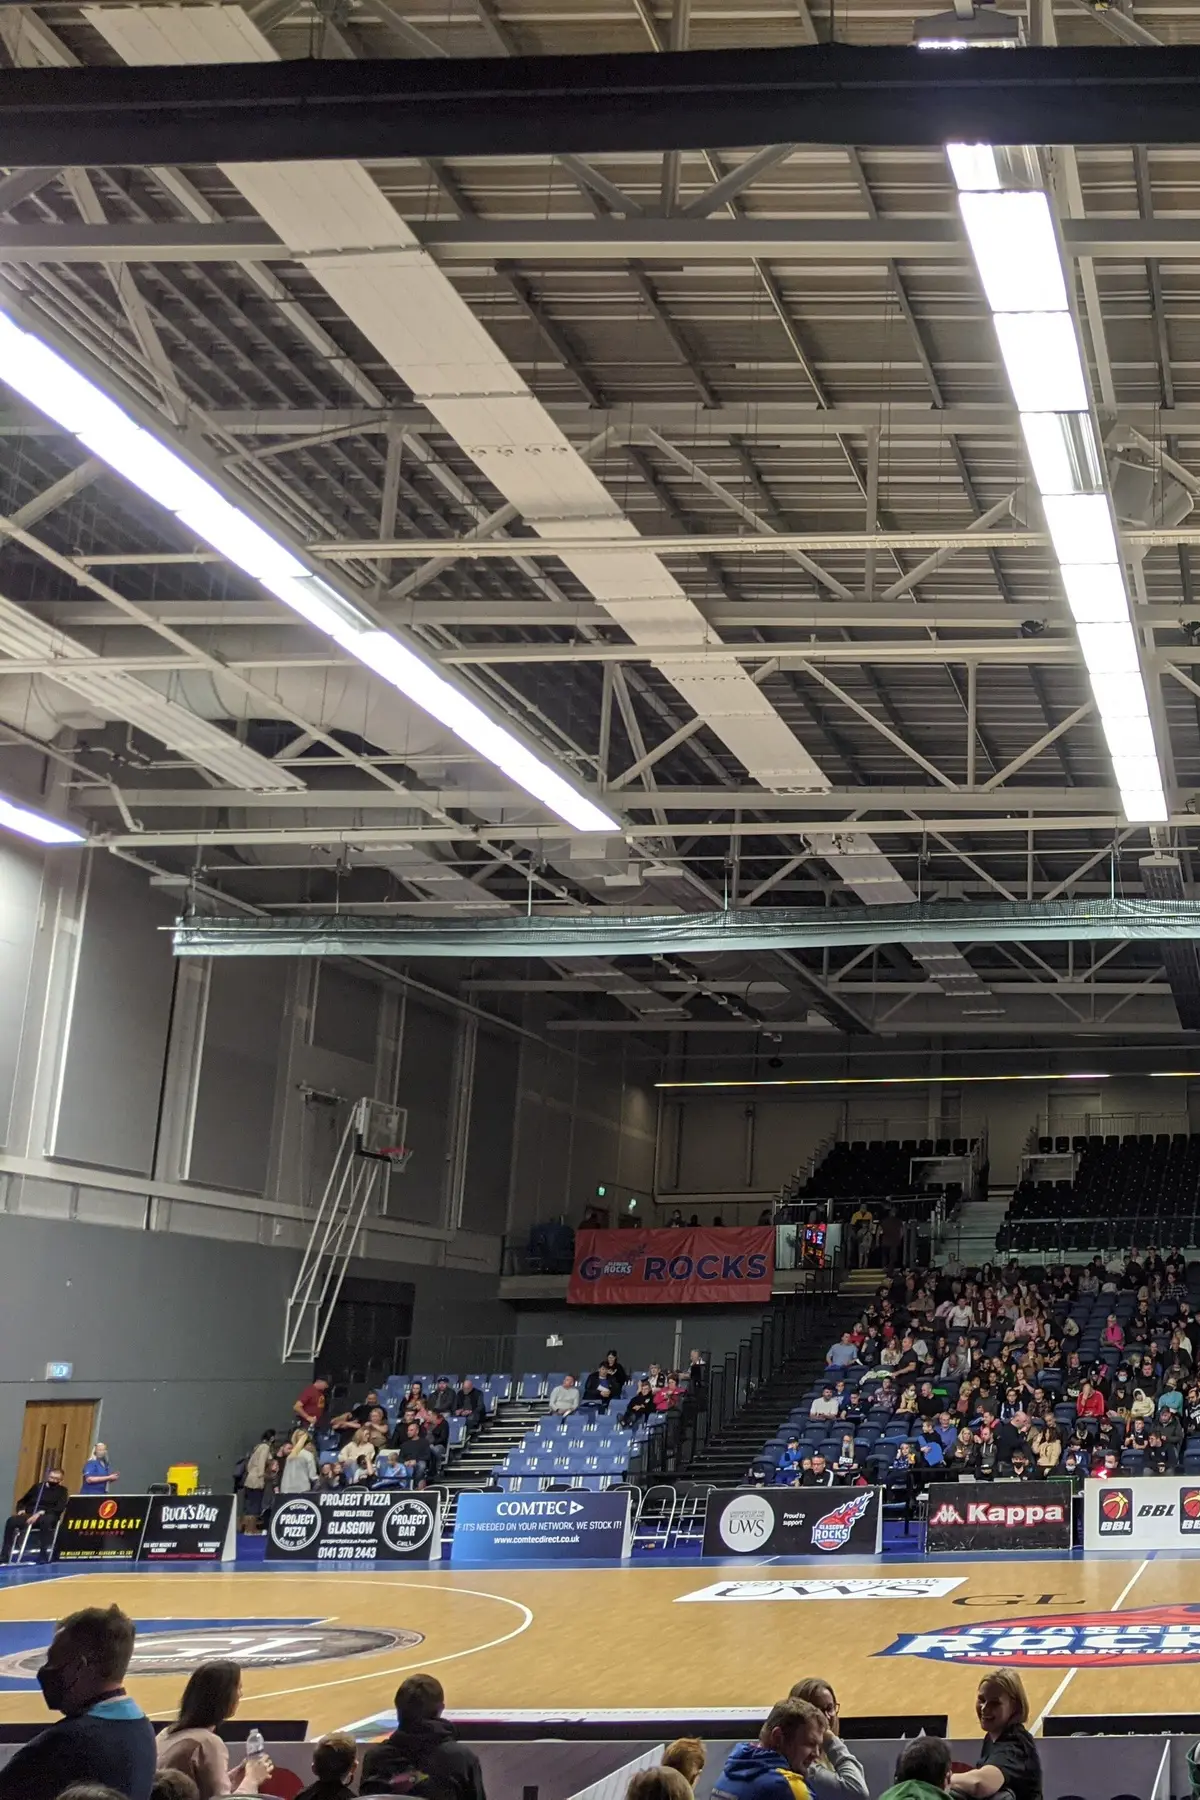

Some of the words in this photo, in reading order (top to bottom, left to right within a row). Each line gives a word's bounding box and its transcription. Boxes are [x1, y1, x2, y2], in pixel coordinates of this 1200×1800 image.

[604, 1265, 632, 1274] ROCKS
[643, 1254, 767, 1281] ROCKS
[320, 1493, 362, 1506] PROJECT
[363, 1493, 391, 1506] PIZZA
[161, 1505, 196, 1522] BUCK'S
[196, 1504, 219, 1522] BAR
[496, 1501, 567, 1515] COMTEC
[967, 1503, 1065, 1526] Kappa
[1137, 1504, 1176, 1517] BBL
[68, 1519, 141, 1530] THUNDERCAT
[280, 1514, 315, 1525] PROJECT
[391, 1514, 427, 1525] PROJECT
[476, 1522, 504, 1531] NEEDED
[506, 1522, 517, 1531] ON
[518, 1522, 537, 1531] YOUR
[538, 1521, 574, 1531] NETWORK,
[576, 1521, 589, 1530] WE
[589, 1521, 612, 1530] STOCK
[613, 1520, 622, 1529] IT!
[782, 1519, 803, 1527] support
[283, 1526, 307, 1537] PIZZA
[327, 1521, 375, 1535] GLASGOW
[398, 1526, 416, 1537] BAR
[728, 1519, 765, 1537] UWS
[1100, 1520, 1132, 1533] BBL
[494, 1535, 580, 1544] www.comtecdirect.co.uk
[814, 1528, 848, 1540] ROCKS
[318, 1546, 337, 1559] 0141
[338, 1546, 354, 1559] 378
[354, 1546, 377, 1559] 2443
[714, 1583, 934, 1597] UWS
[951, 1593, 1086, 1606] GL
